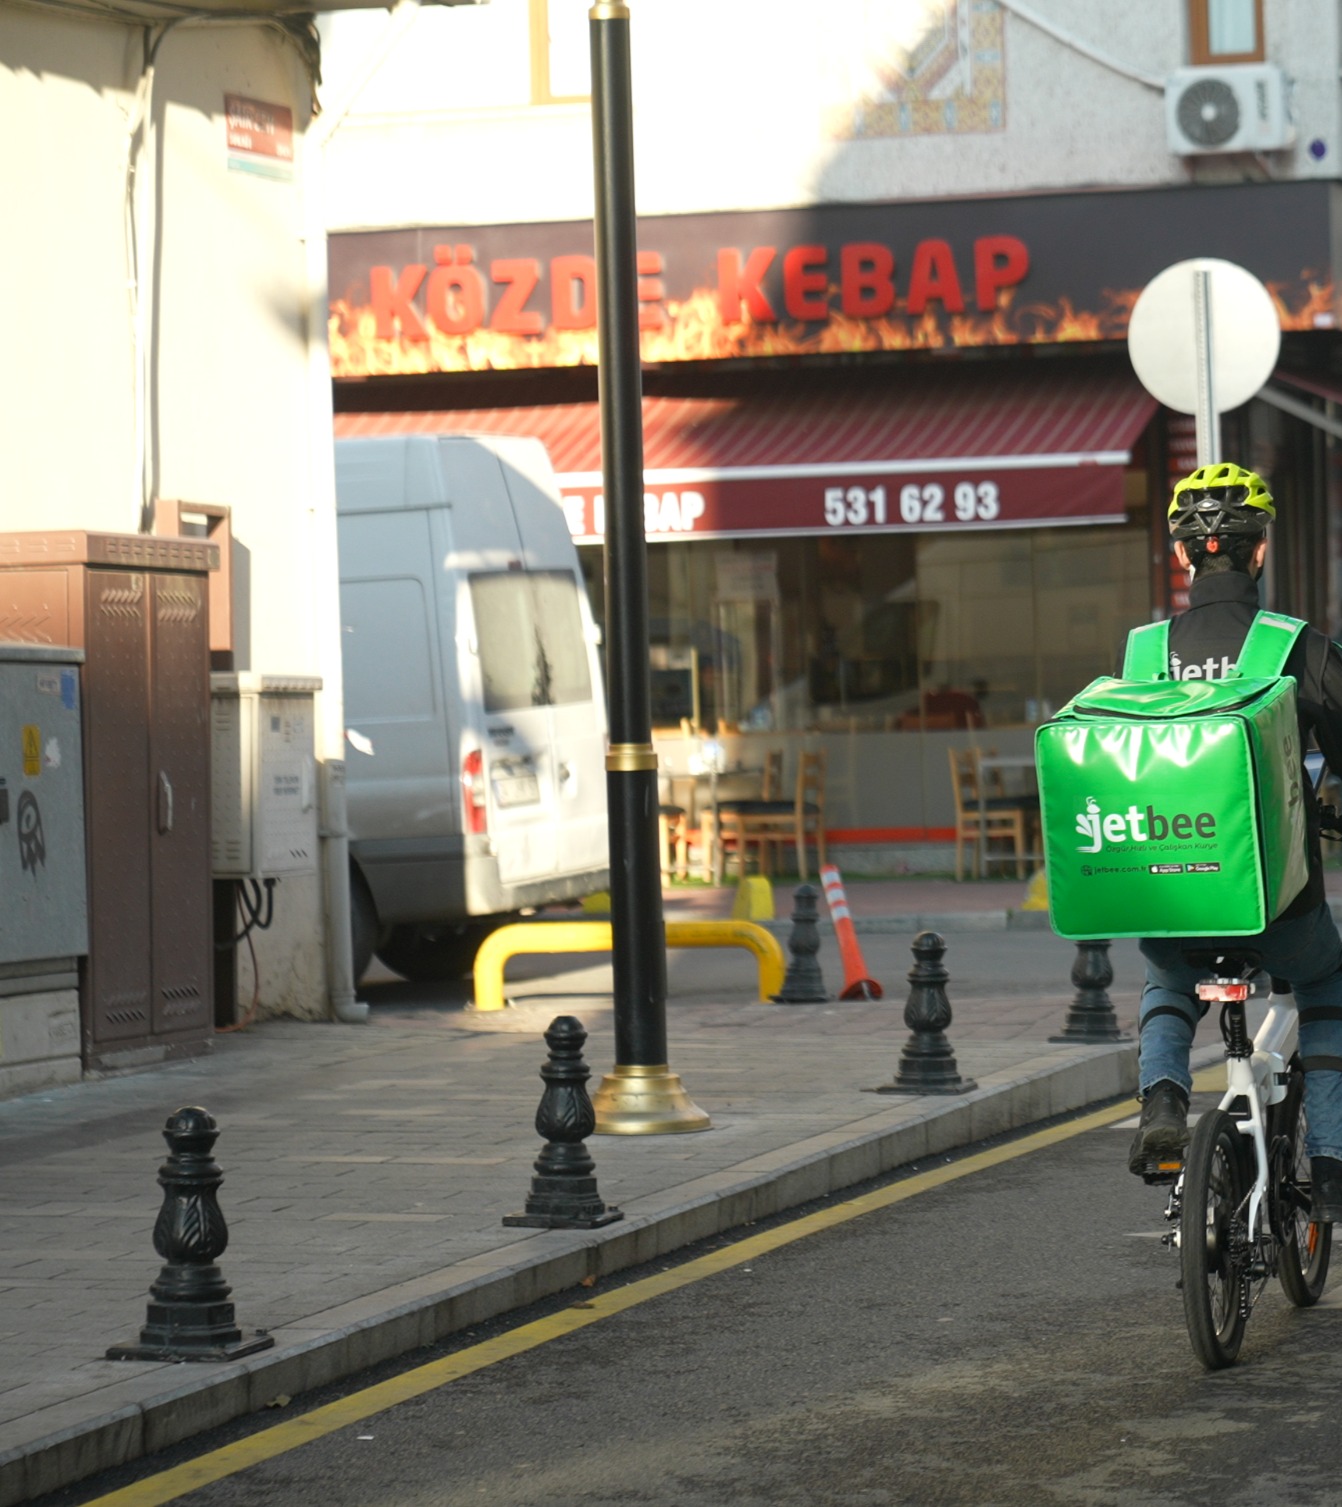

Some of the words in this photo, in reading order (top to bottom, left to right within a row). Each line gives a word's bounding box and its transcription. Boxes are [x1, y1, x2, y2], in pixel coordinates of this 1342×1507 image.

[717, 235, 1030, 325] KEBAP
[824, 485, 887, 527] 531
[899, 483, 945, 523] 62
[954, 480, 1000, 522] 93
[1076, 797, 1217, 853] jetbee
